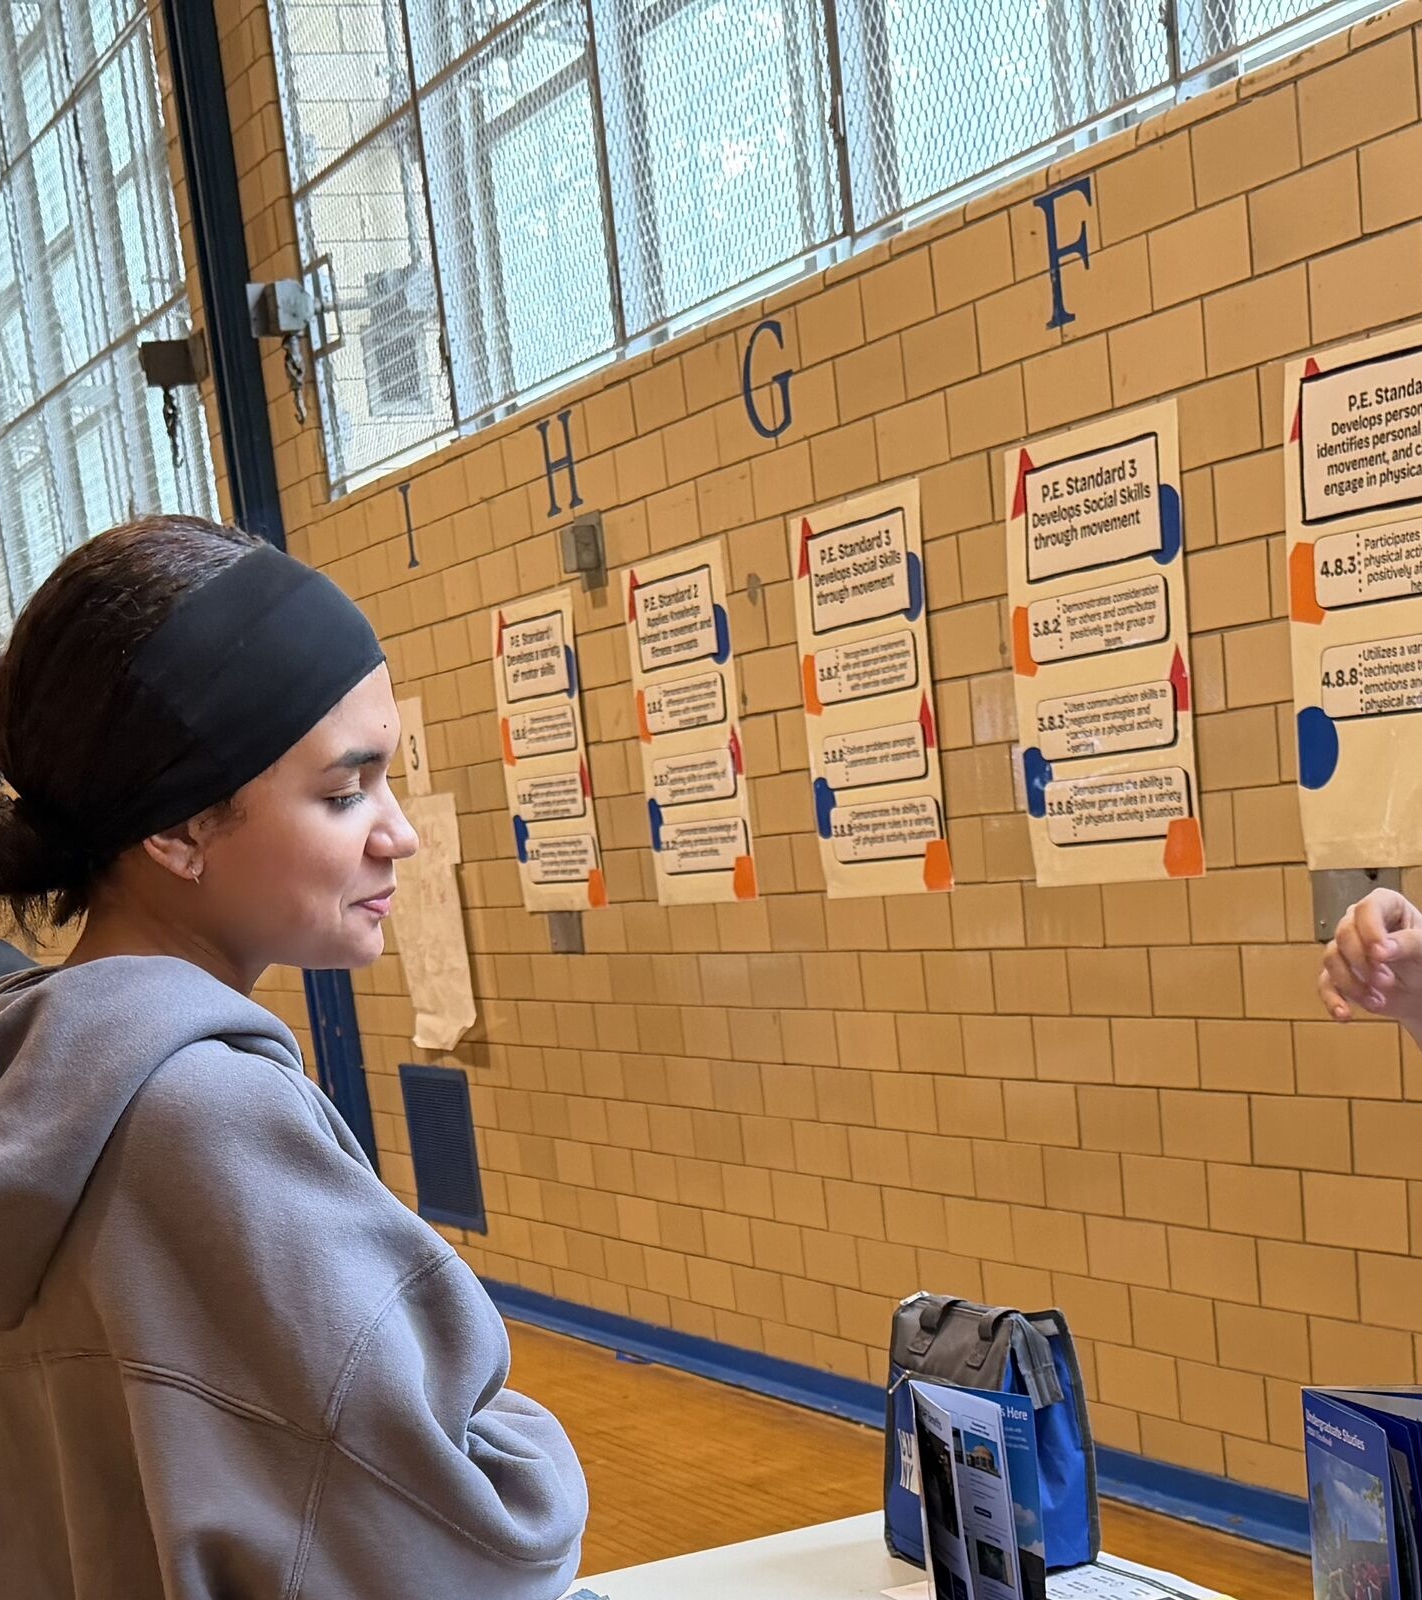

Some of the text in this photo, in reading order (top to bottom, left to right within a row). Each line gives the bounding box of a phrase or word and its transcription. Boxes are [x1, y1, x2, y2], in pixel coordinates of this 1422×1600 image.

[1034, 177, 1093, 330] F
[742, 321, 794, 439] G
[1348, 392, 1372, 411] P.E.
[1332, 411, 1382, 436] Develops
[1317, 436, 1370, 459] identifies
[1372, 421, 1421, 448] personal
[535, 411, 584, 517] H
[1327, 451, 1389, 476] movement,
[1392, 444, 1413, 461] and
[1041, 459, 1137, 503] P.E. Standard 3
[1324, 475, 1363, 496] engage
[1366, 471, 1377, 487] in
[1032, 482, 1151, 528] Develops Social Skills
[398, 483, 419, 568] I
[1034, 509, 1140, 550] through movement
[820, 529, 891, 565] P.E. Standard 3
[1364, 528, 1420, 551] Participates
[814, 550, 901, 588] Develops Social Skills
[1320, 556, 1357, 578] 4.8.3
[1364, 548, 1403, 569] physical
[1367, 564, 1412, 586] positively
[659, 585, 691, 608] Standard
[817, 574, 895, 606] through movement
[1062, 584, 1159, 614] Demonstrates consideration
[1066, 600, 1156, 627] for others and contributes
[1032, 619, 1061, 638] 3.8.2
[1070, 626, 1103, 642] positively
[1112, 621, 1124, 632] the
[1126, 620, 1146, 634] group
[1362, 644, 1398, 662] Utilizes
[1400, 645, 1405, 656] a
[1322, 668, 1359, 689] 4.8.8
[1364, 660, 1415, 678] techniques
[1364, 679, 1408, 695] emotions
[1087, 693, 1138, 712] communication
[1140, 688, 1158, 702] skills
[1138, 704, 1150, 717] and
[1364, 696, 1404, 714] physical
[1037, 714, 1065, 732] 3.8.3
[1107, 717, 1163, 736] physical activity
[409, 735, 420, 771] 3
[1140, 776, 1164, 793] ability
[1098, 796, 1118, 809] game
[1119, 793, 1137, 806] rules
[1155, 790, 1181, 804] variety
[1085, 806, 1184, 827] physical activity situations
[1006, 1406, 1028, 1420] Here
[1306, 1408, 1365, 1450] Undergraduate Studies
